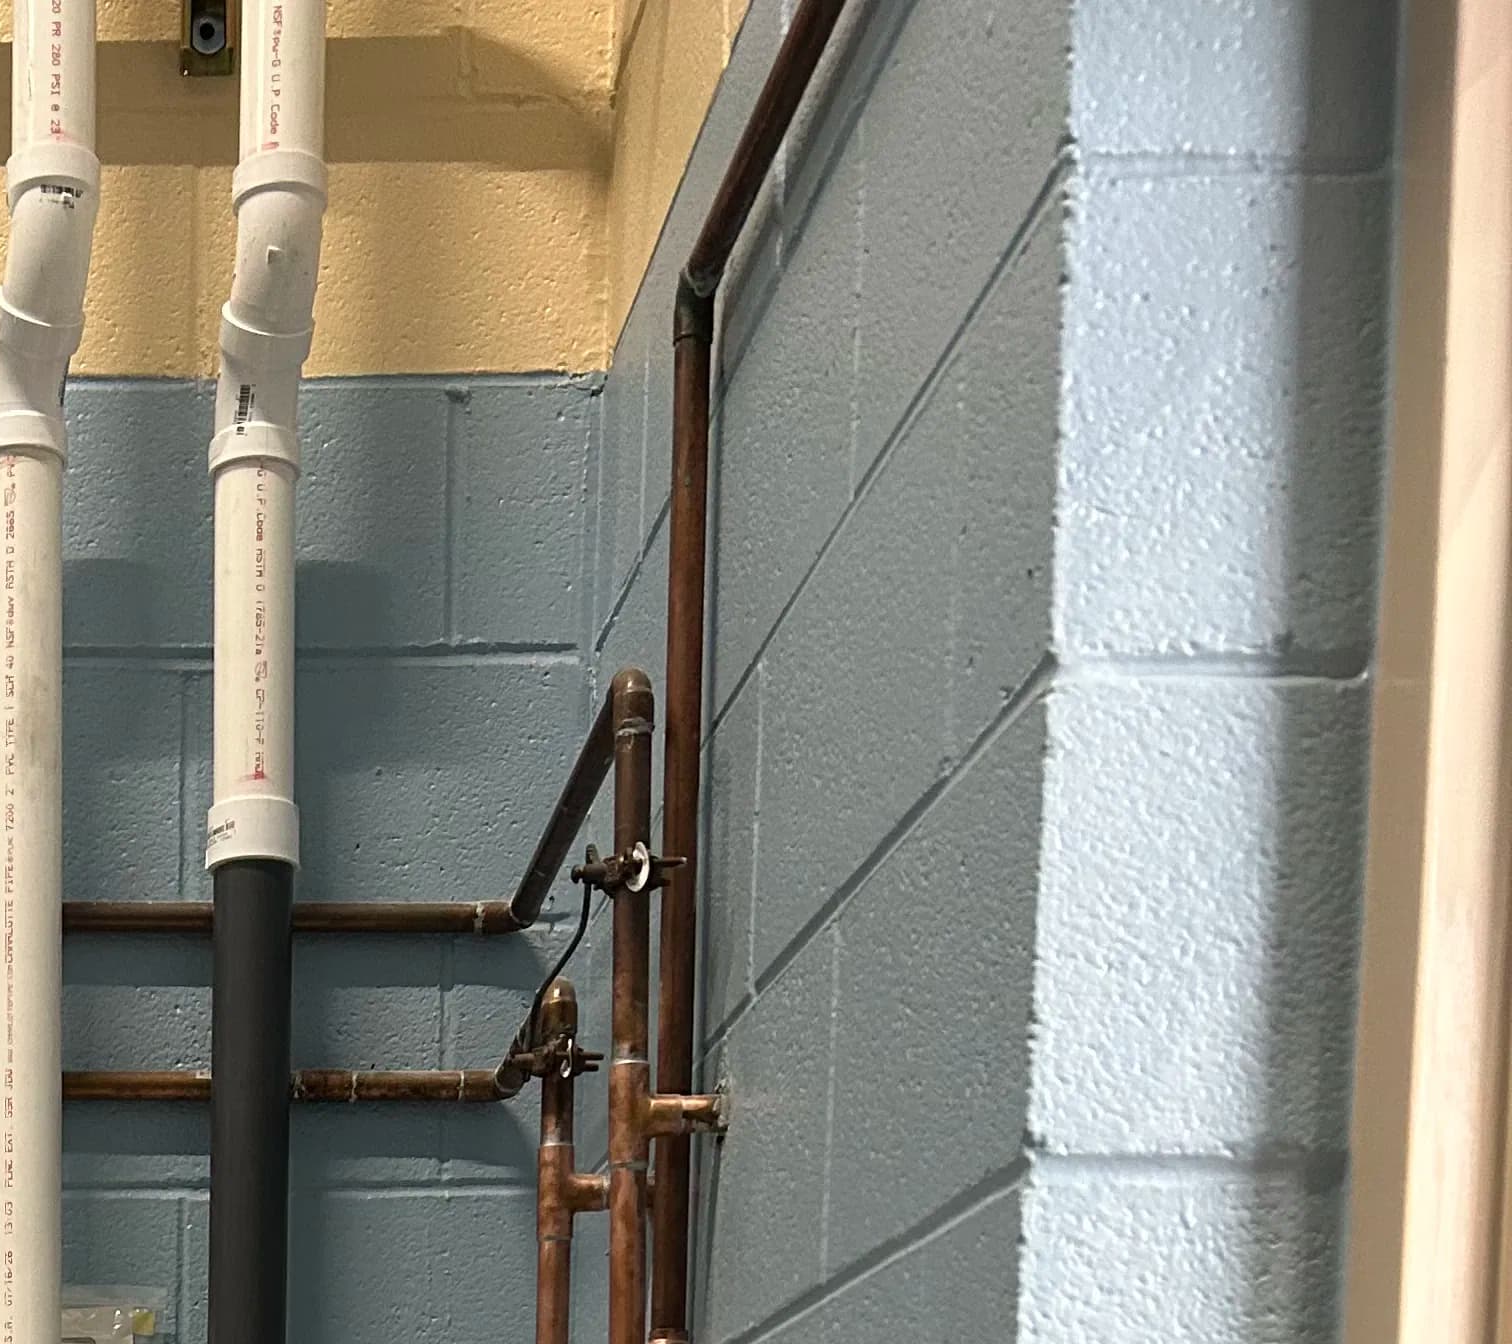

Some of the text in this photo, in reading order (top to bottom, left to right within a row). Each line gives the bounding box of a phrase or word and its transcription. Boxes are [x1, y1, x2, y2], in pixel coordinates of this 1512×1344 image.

[51, 21, 62, 37] PR
[51, 73, 62, 96] PSI
[270, 104, 281, 135] Code
[5, 560, 16, 589] ASTM
[5, 655, 16, 669] 40
[5, 753, 15, 775] PVC
[4, 803, 15, 831] 7200
[4, 864, 14, 893] PIPE
[4, 900, 14, 963] CHARLOTTE
